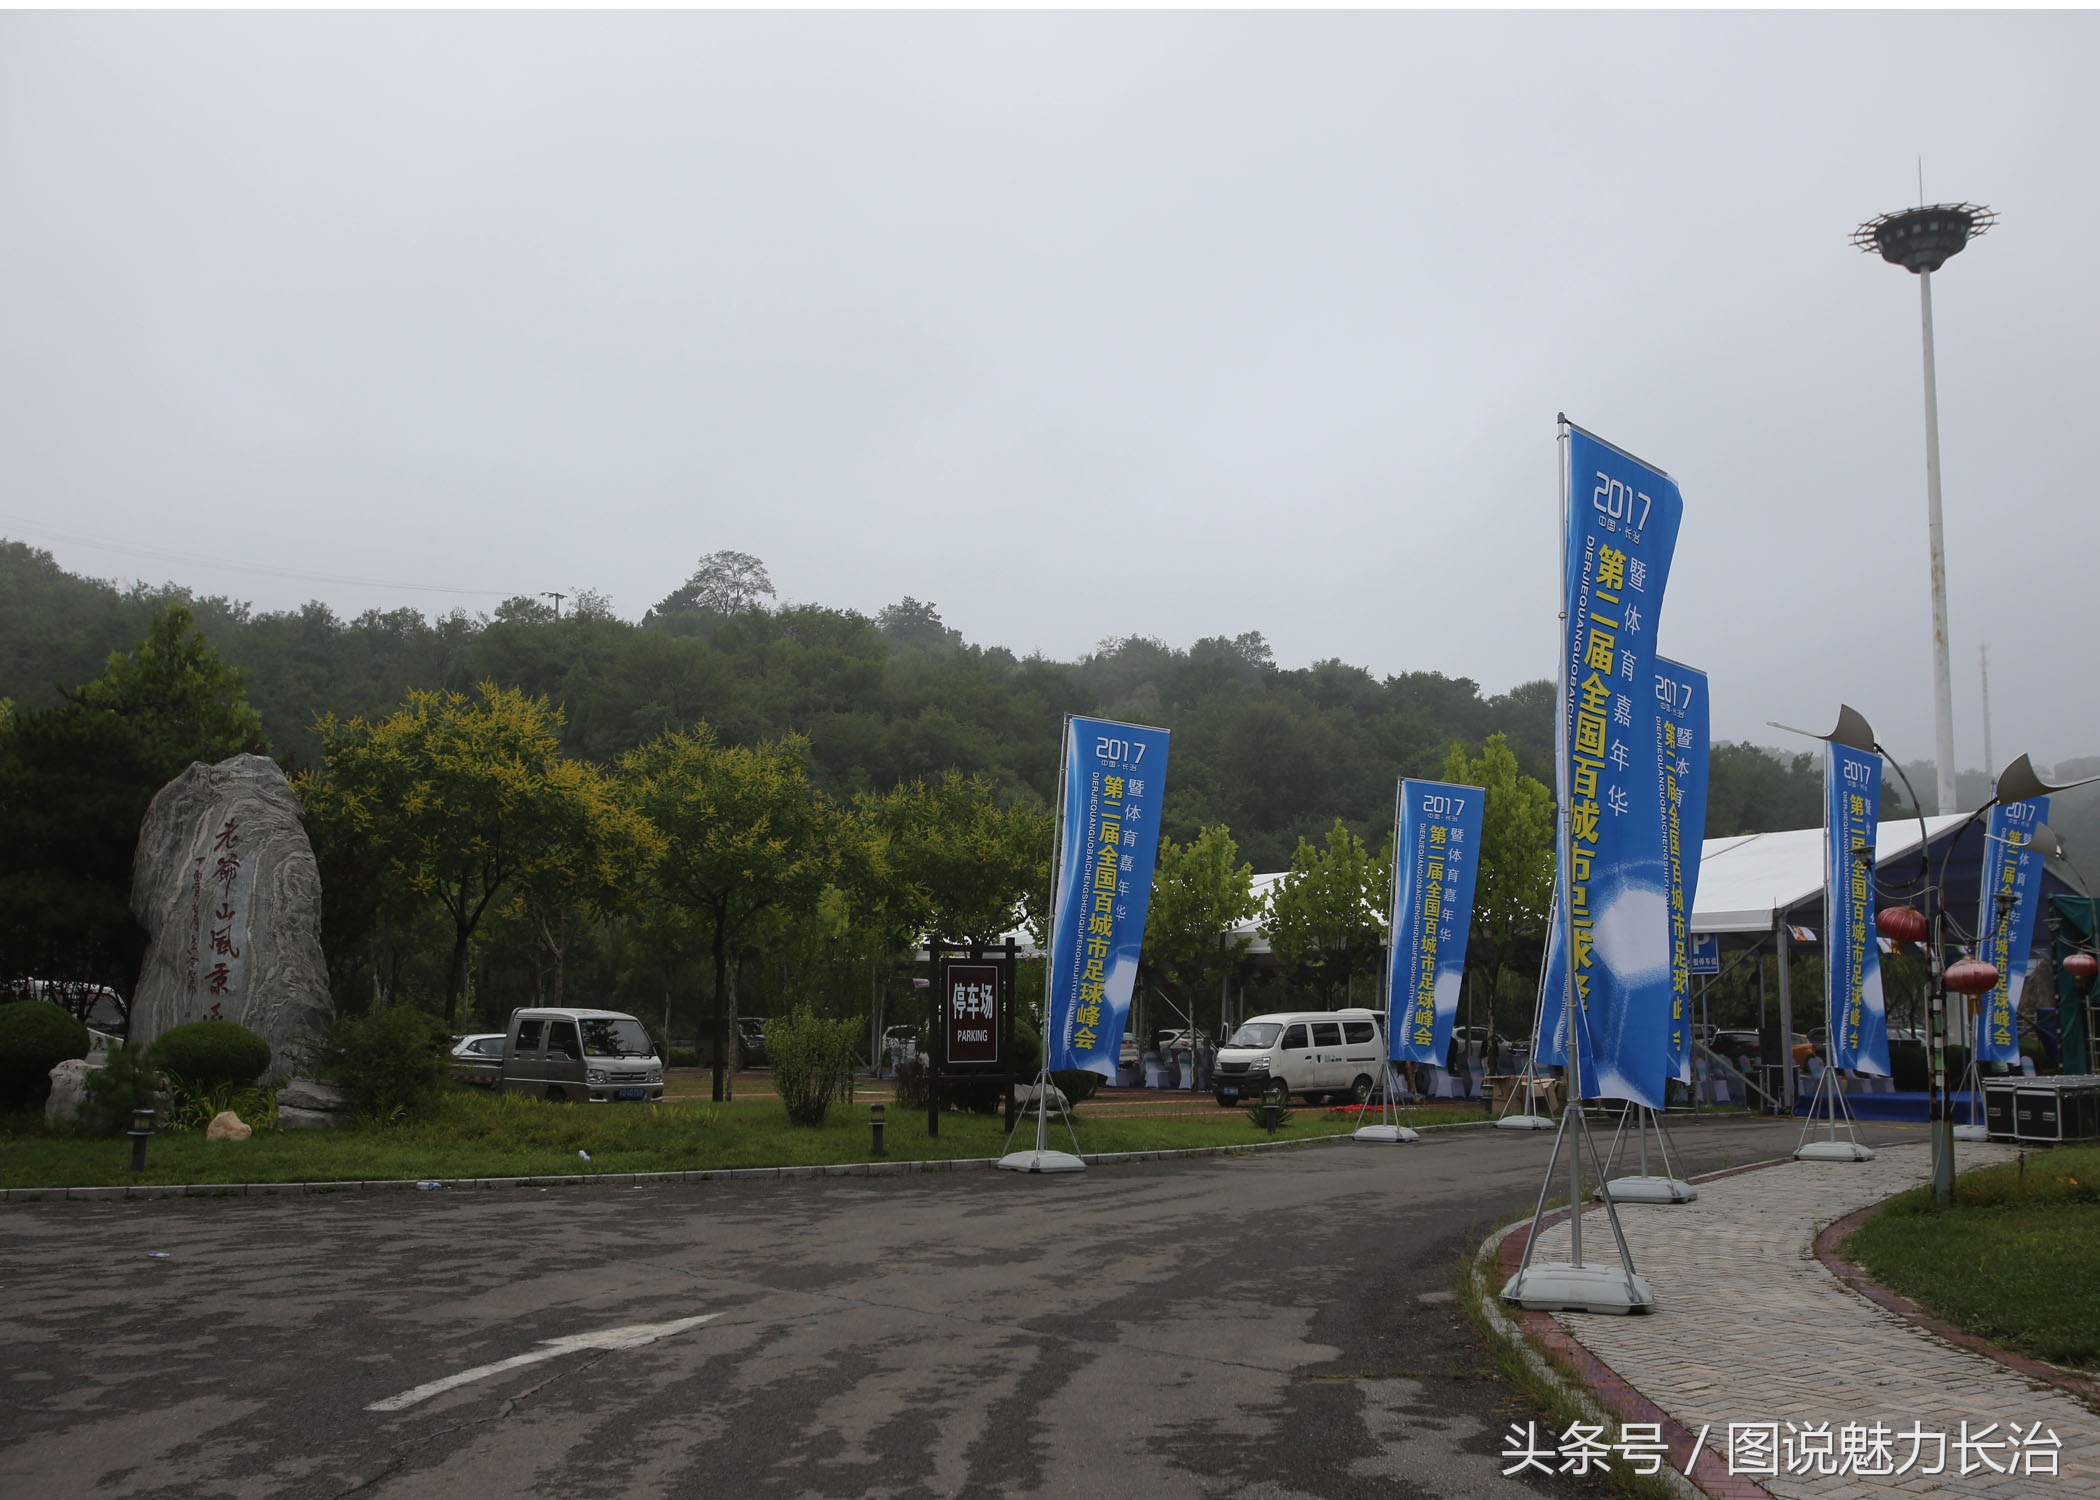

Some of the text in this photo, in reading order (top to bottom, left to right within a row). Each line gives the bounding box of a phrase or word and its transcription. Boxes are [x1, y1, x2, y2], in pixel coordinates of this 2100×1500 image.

[1593, 471, 1652, 531] 2017
[1607, 557, 1647, 817] 暨体育嘉年华
[1654, 674, 1693, 710] 2017
[1096, 736, 1146, 764] 2017
[1843, 759, 1871, 785] 2017
[1423, 794, 1466, 816] 2017
[2005, 801, 2036, 821] 2017
[1115, 778, 1145, 921] 暨体育嘉年华
[1438, 827, 1465, 942] 暨体育嘉年华
[1073, 774, 1126, 1050] 第二届全国百城市足球峰会
[1413, 825, 1448, 1047] 第二届全国百城市足球峰会
[1693, 933, 1711, 954] P
[952, 982, 993, 1020] 停车场
[957, 1029, 988, 1042] PARKING
